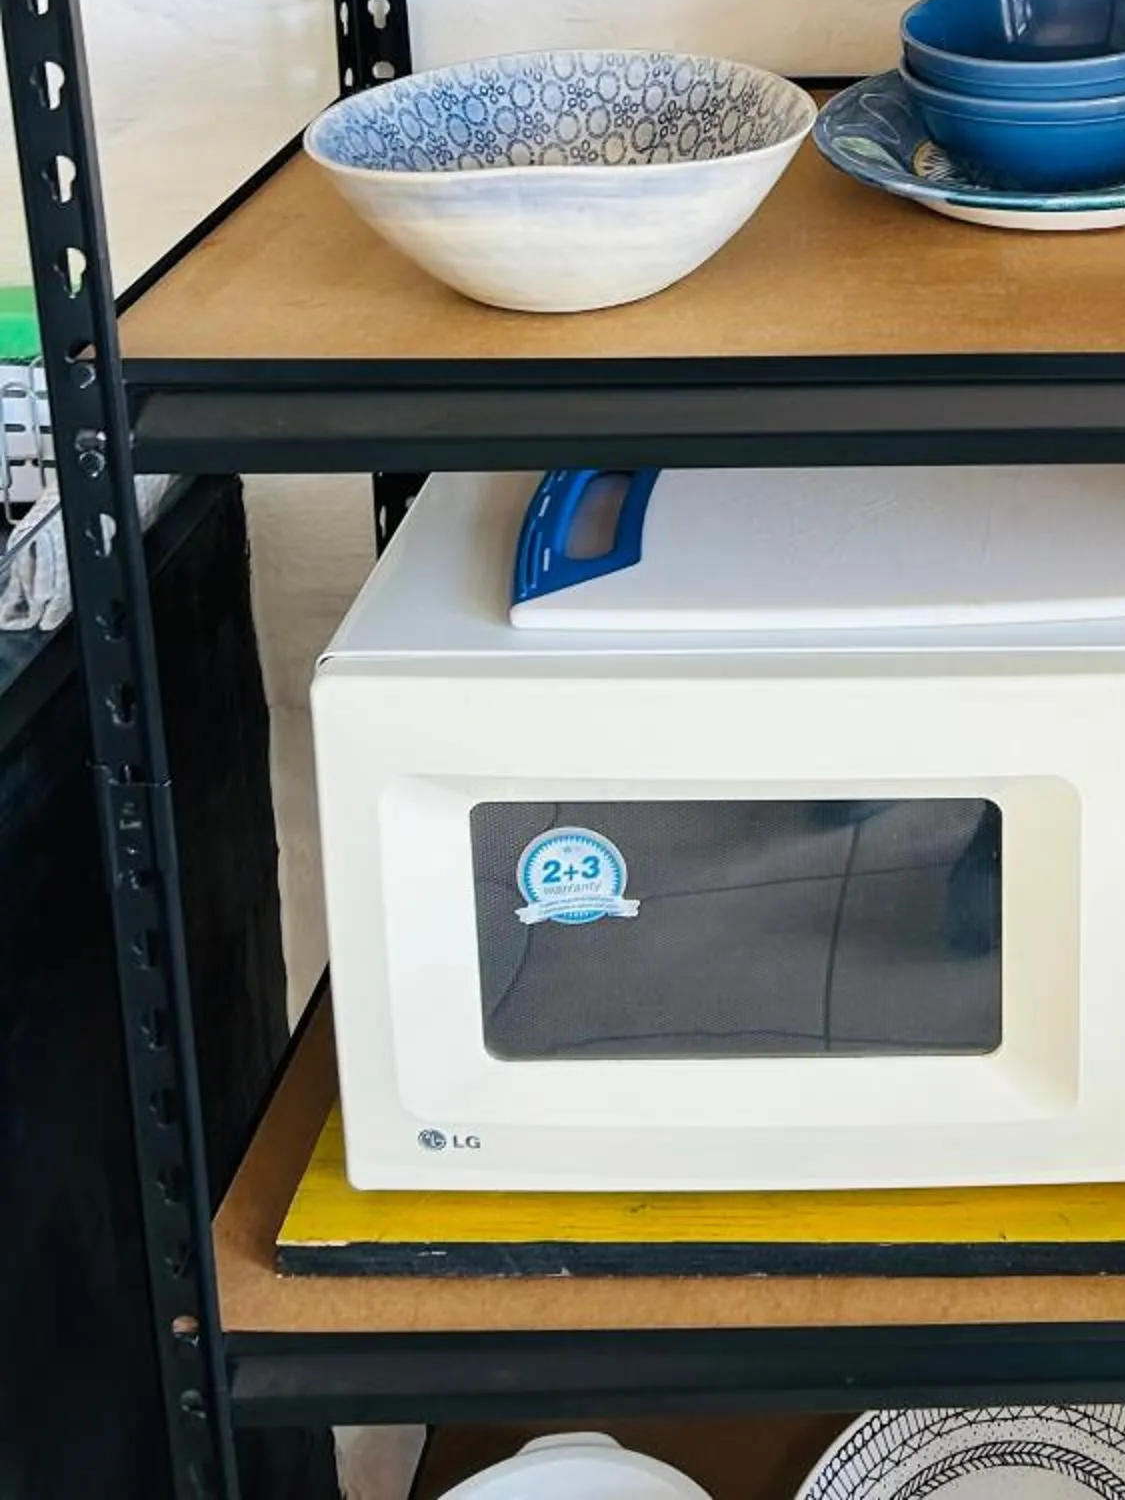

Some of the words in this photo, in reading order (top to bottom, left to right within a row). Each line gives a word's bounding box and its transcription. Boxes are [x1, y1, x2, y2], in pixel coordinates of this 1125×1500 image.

[542, 855, 601, 884] 2+3
[543, 880, 602, 895] warranty
[453, 1134, 481, 1149] LG
